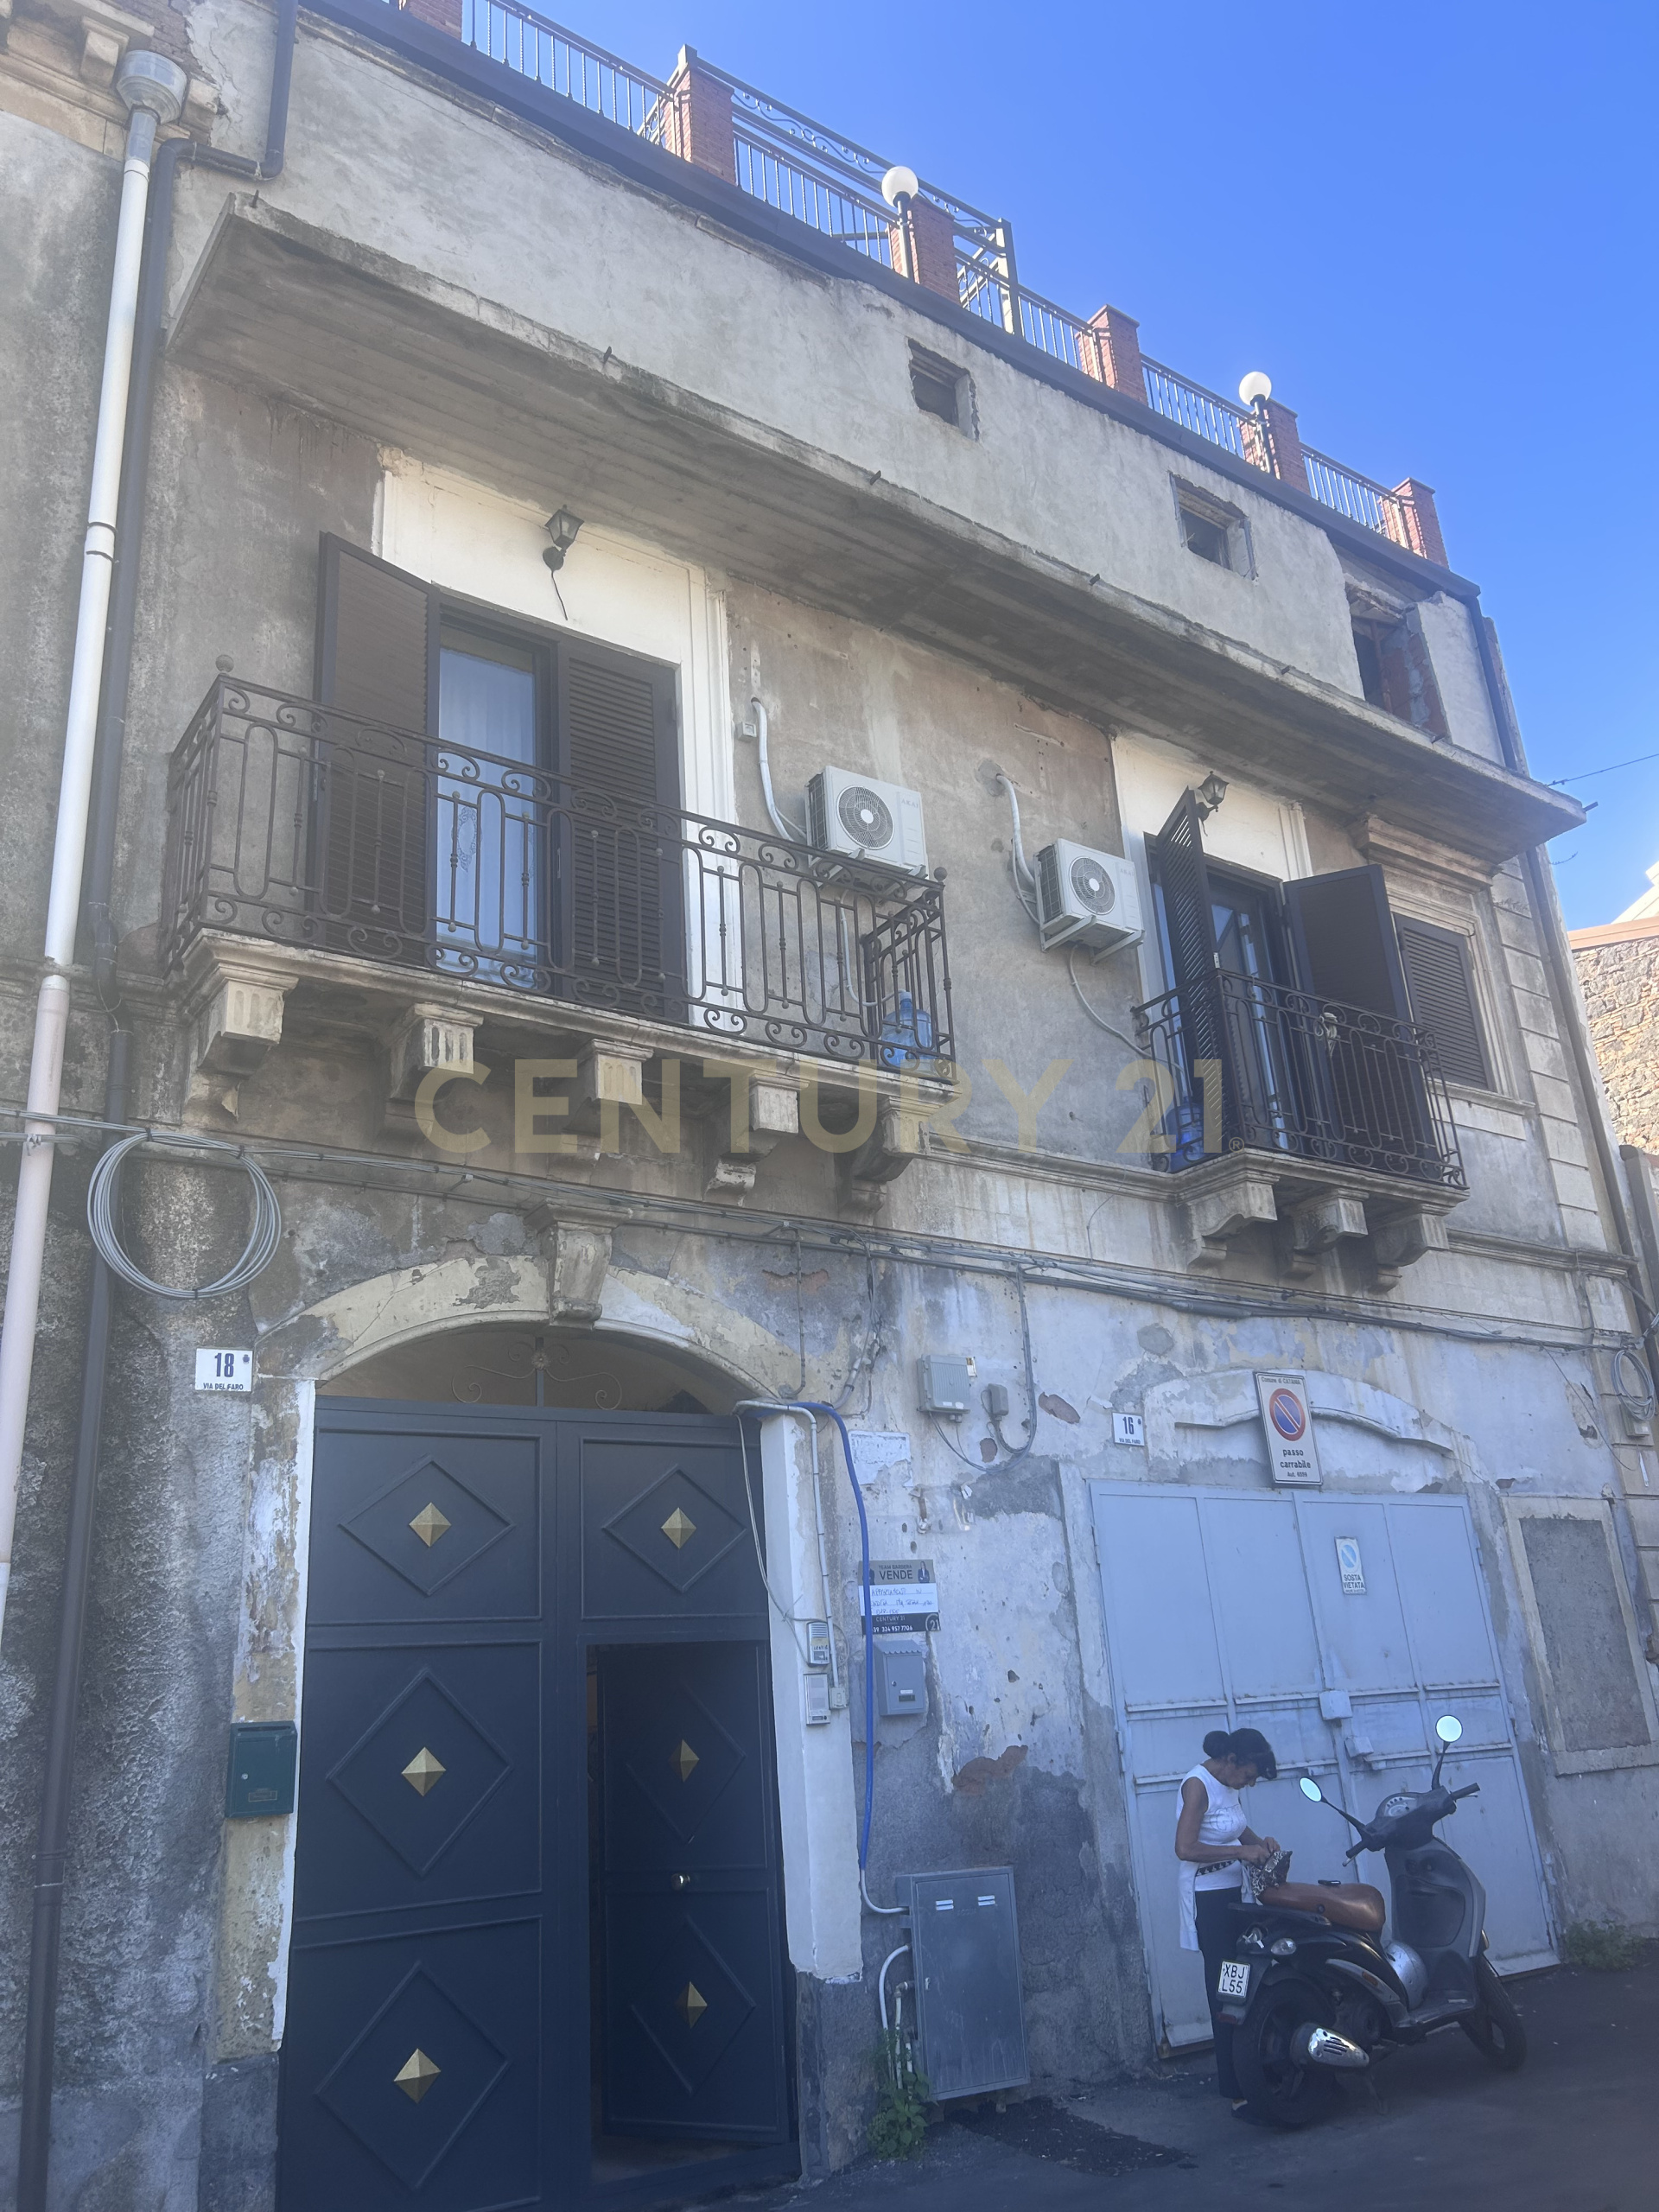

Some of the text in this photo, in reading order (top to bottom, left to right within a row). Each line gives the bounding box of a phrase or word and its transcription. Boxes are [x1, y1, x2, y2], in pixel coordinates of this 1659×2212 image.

[214, 1352, 234, 1377] 18
[1122, 1416, 1135, 1434] 16
[1280, 1459, 1312, 1469] carrabile
[879, 1569, 913, 1580] VENDE
[930, 1619, 940, 1630] 21
[1224, 1964, 1245, 1979] XBJ
[1222, 1979, 1243, 1993] L55
